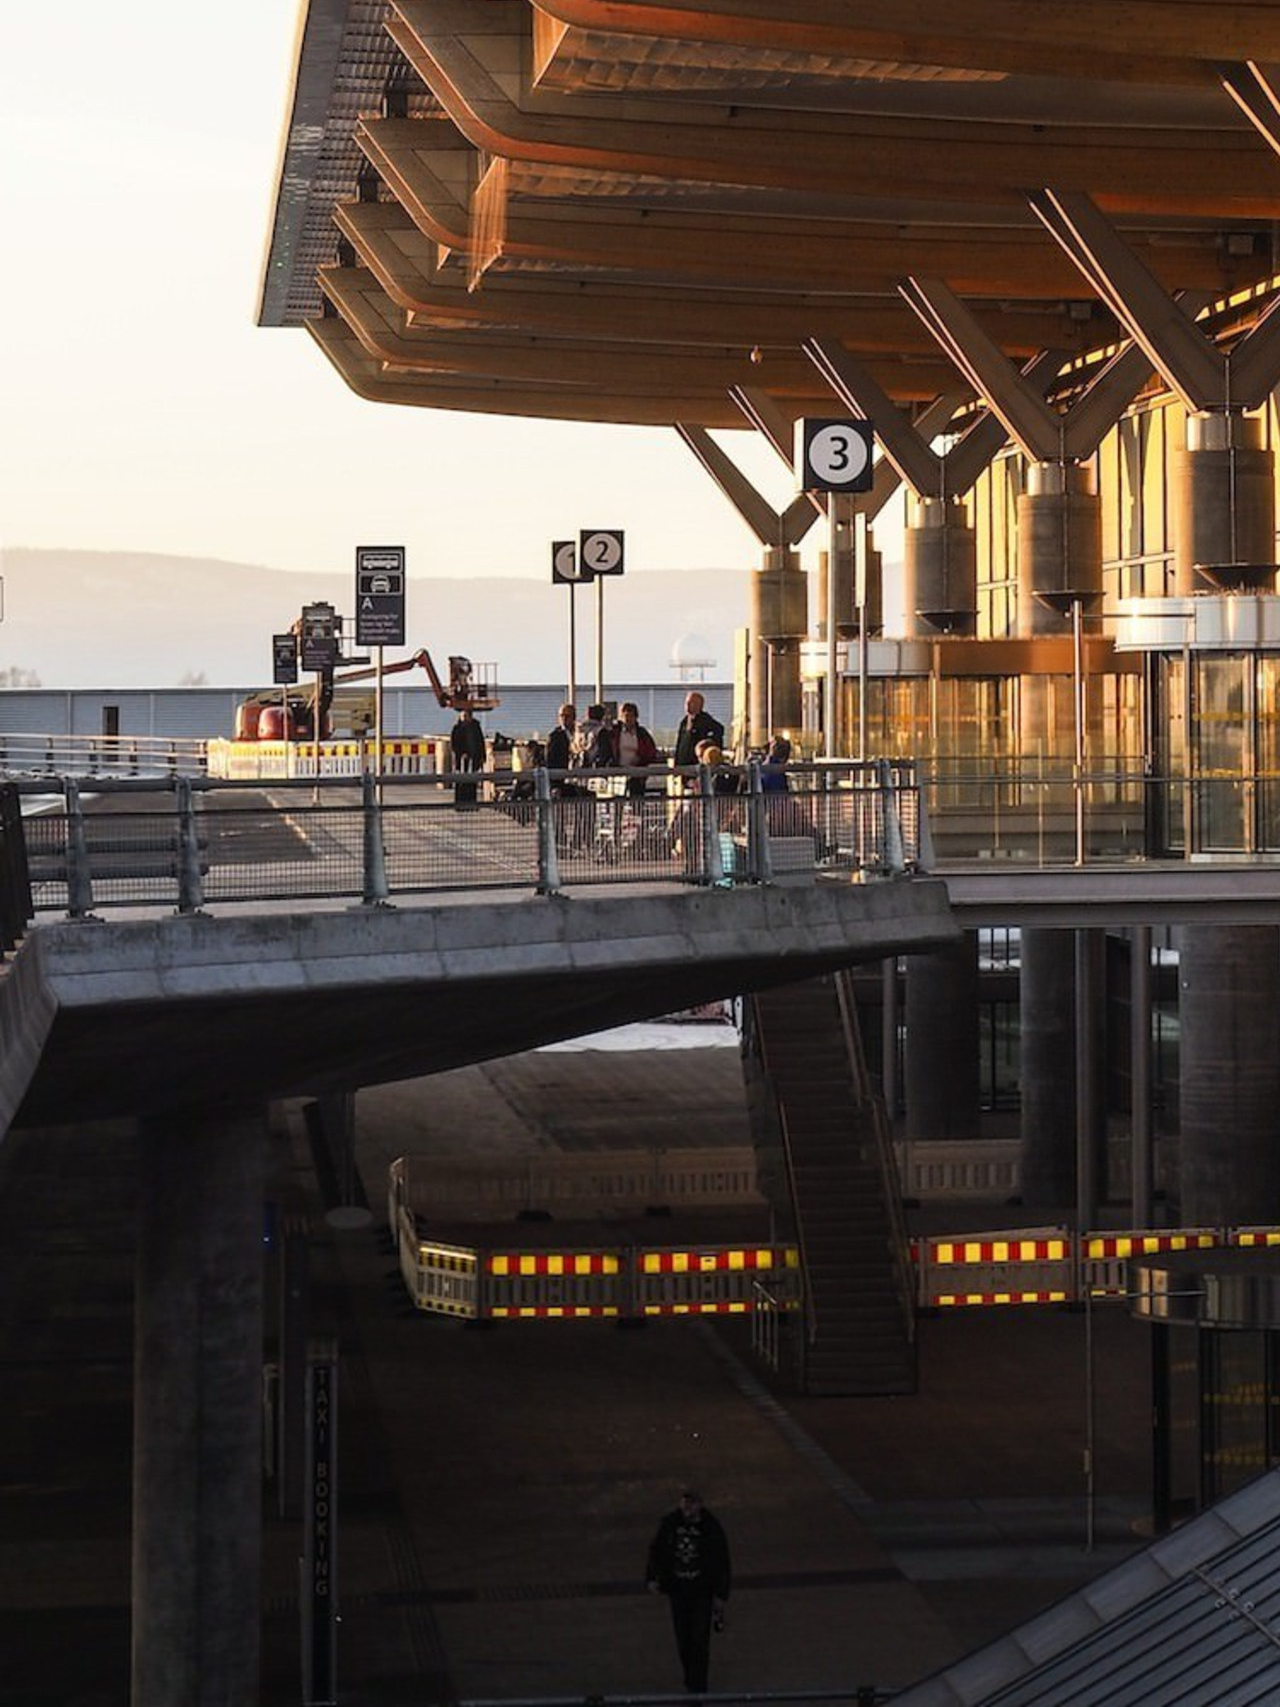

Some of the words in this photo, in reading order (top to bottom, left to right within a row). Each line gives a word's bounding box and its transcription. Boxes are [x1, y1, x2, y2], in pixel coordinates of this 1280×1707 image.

[828, 436, 849, 471] 3
[595, 540, 609, 563] 2
[361, 597, 374, 610] A
[315, 1369, 328, 1445] TAXI
[314, 1462, 329, 1597] BOOKING
